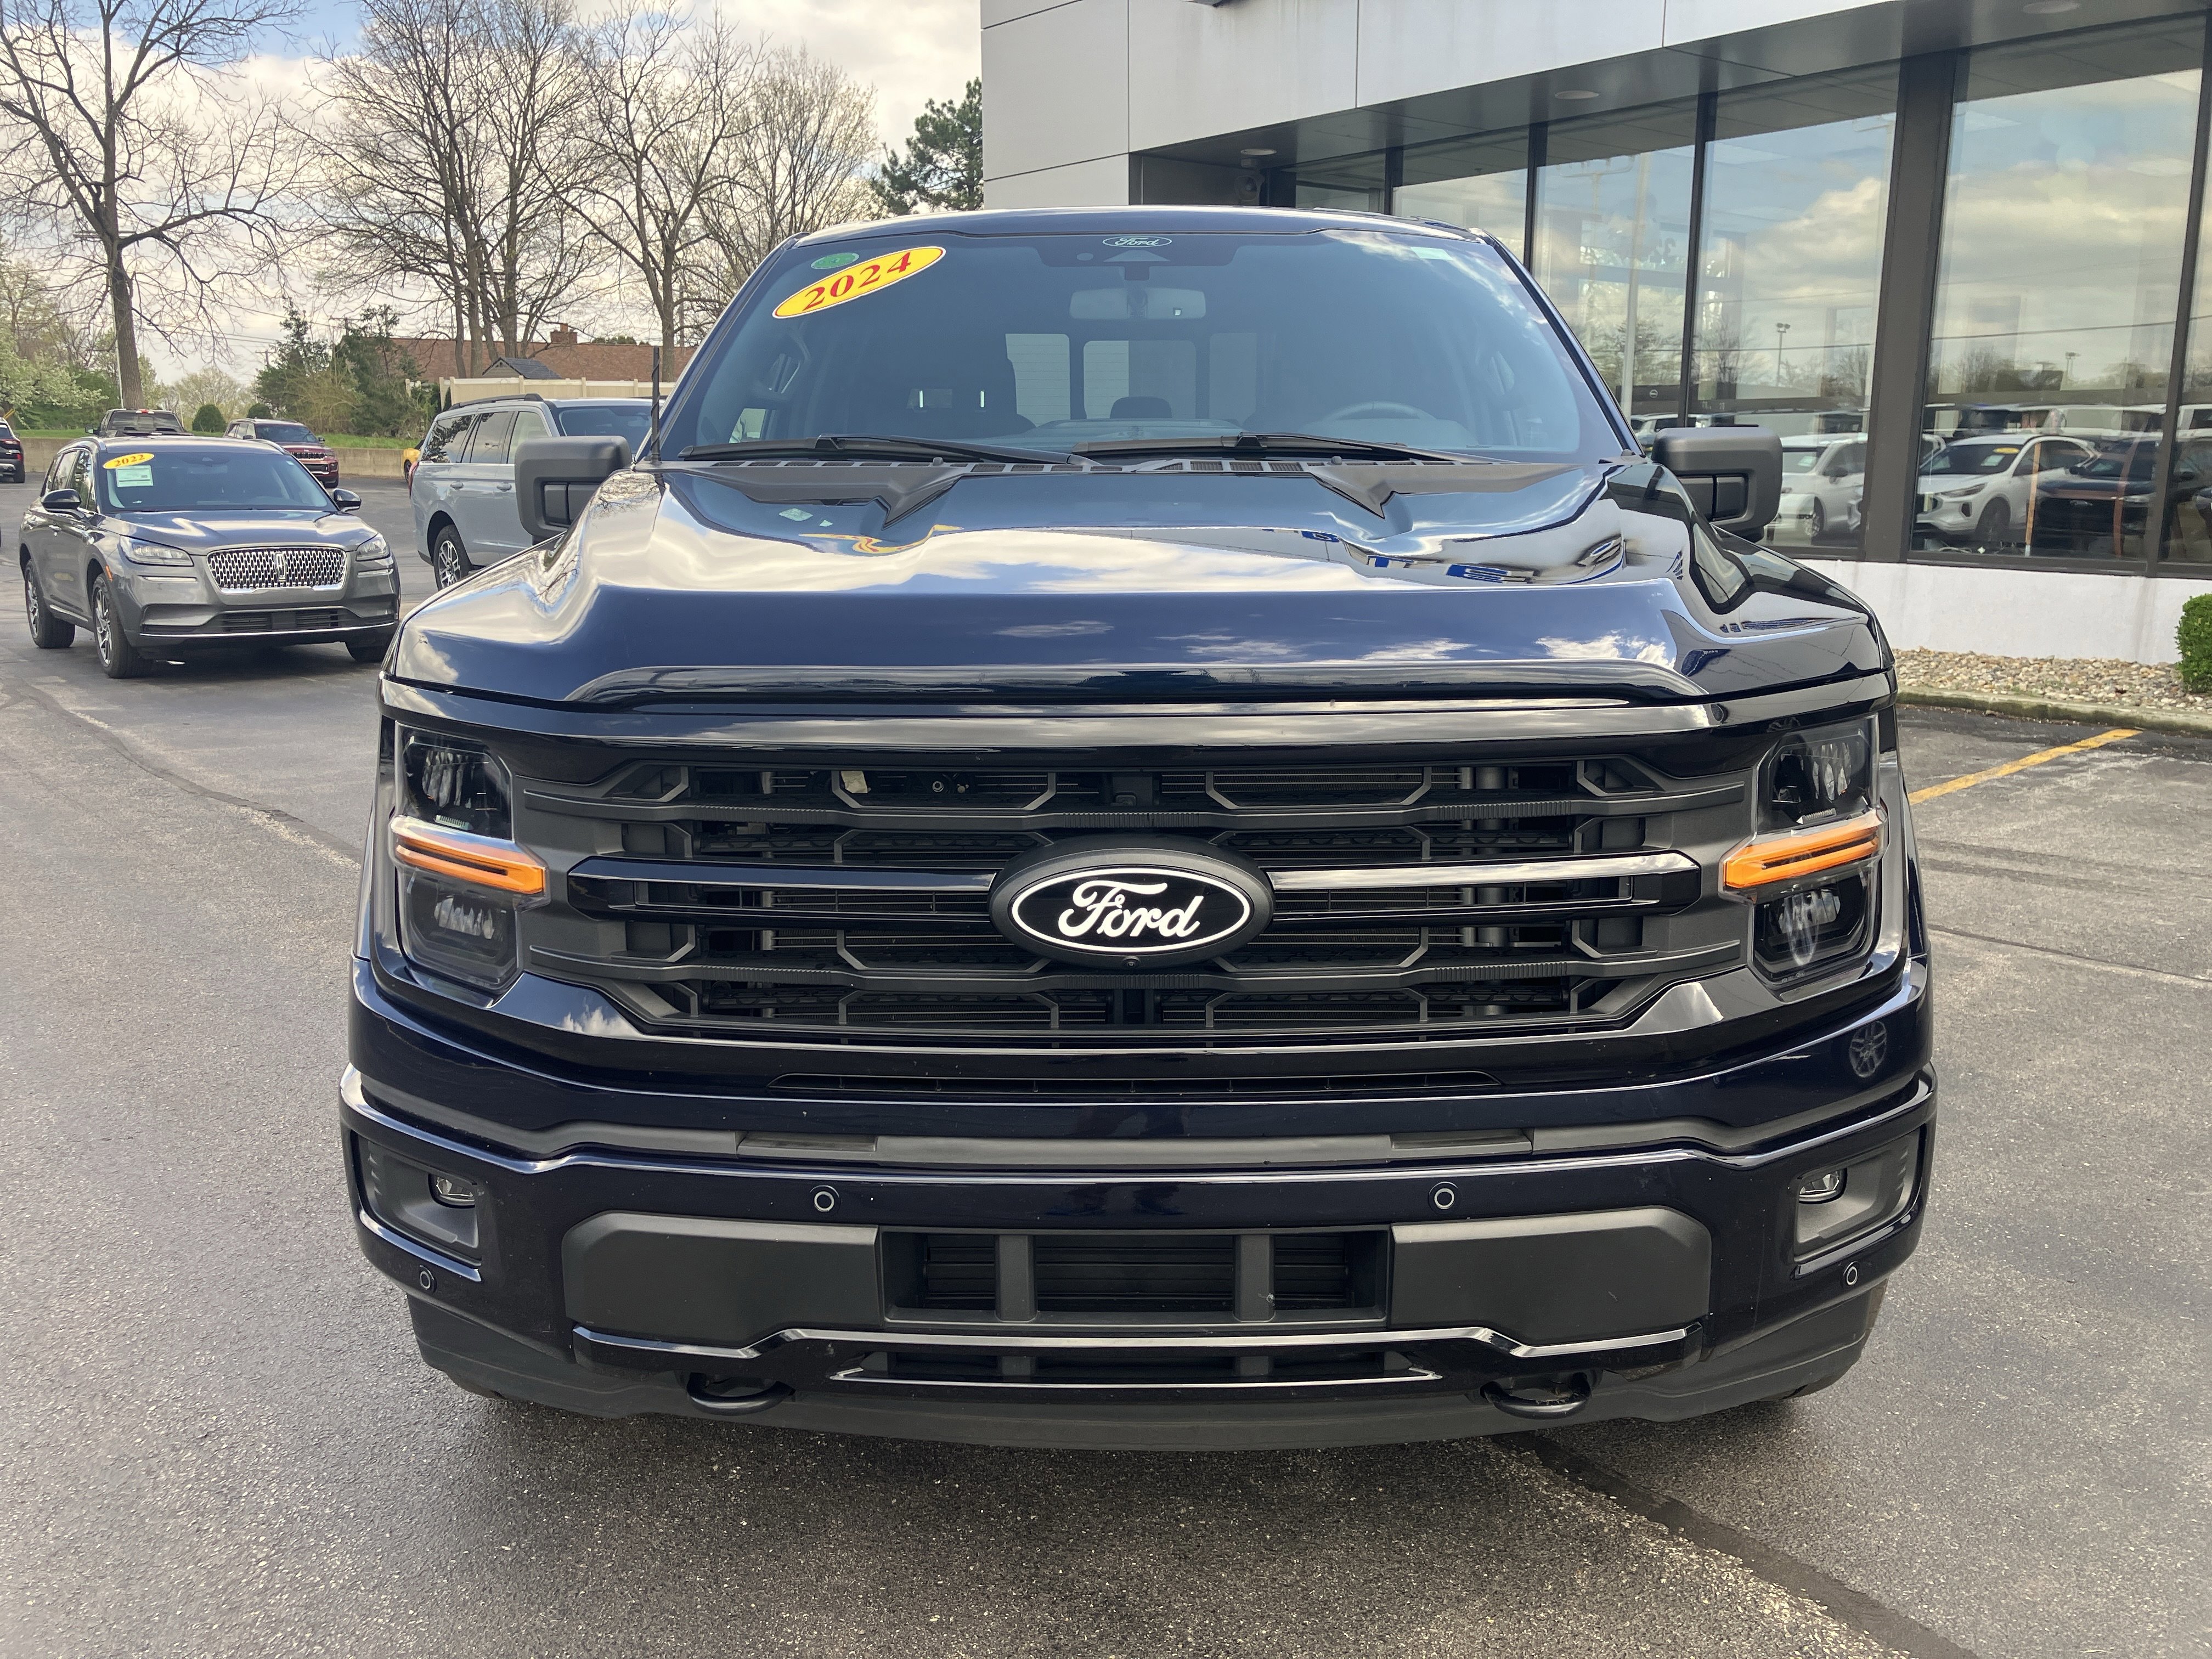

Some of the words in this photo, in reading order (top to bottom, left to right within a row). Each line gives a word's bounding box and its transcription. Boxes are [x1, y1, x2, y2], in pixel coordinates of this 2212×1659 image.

[1114, 237, 1160, 245] Ford
[802, 252, 911, 311] 2024
[115, 455, 145, 467] 2022
[1058, 880, 1204, 937] Ford
